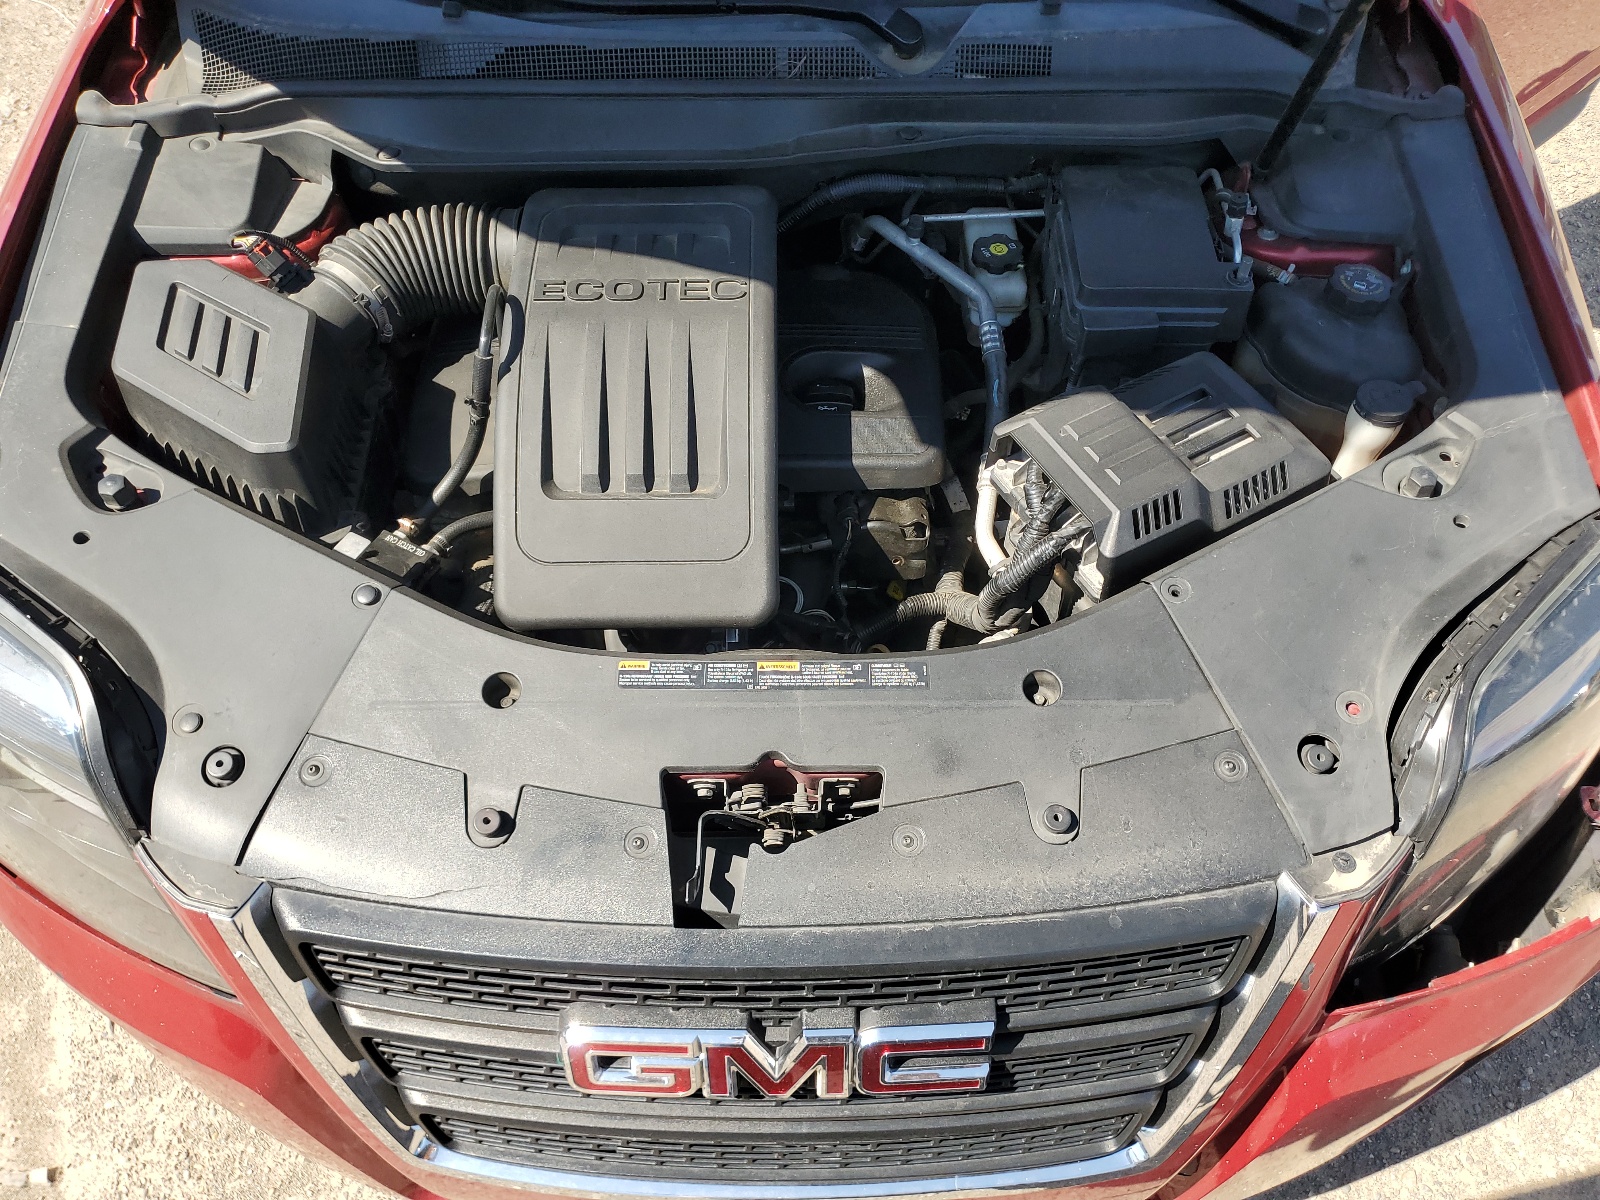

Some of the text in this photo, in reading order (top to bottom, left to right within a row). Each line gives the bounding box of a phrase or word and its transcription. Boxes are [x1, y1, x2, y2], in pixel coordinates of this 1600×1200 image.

[533, 277, 748, 301] ECOTEC
[384, 534, 426, 557] OIL CATCH CAN
[561, 1020, 995, 1099] GMC
